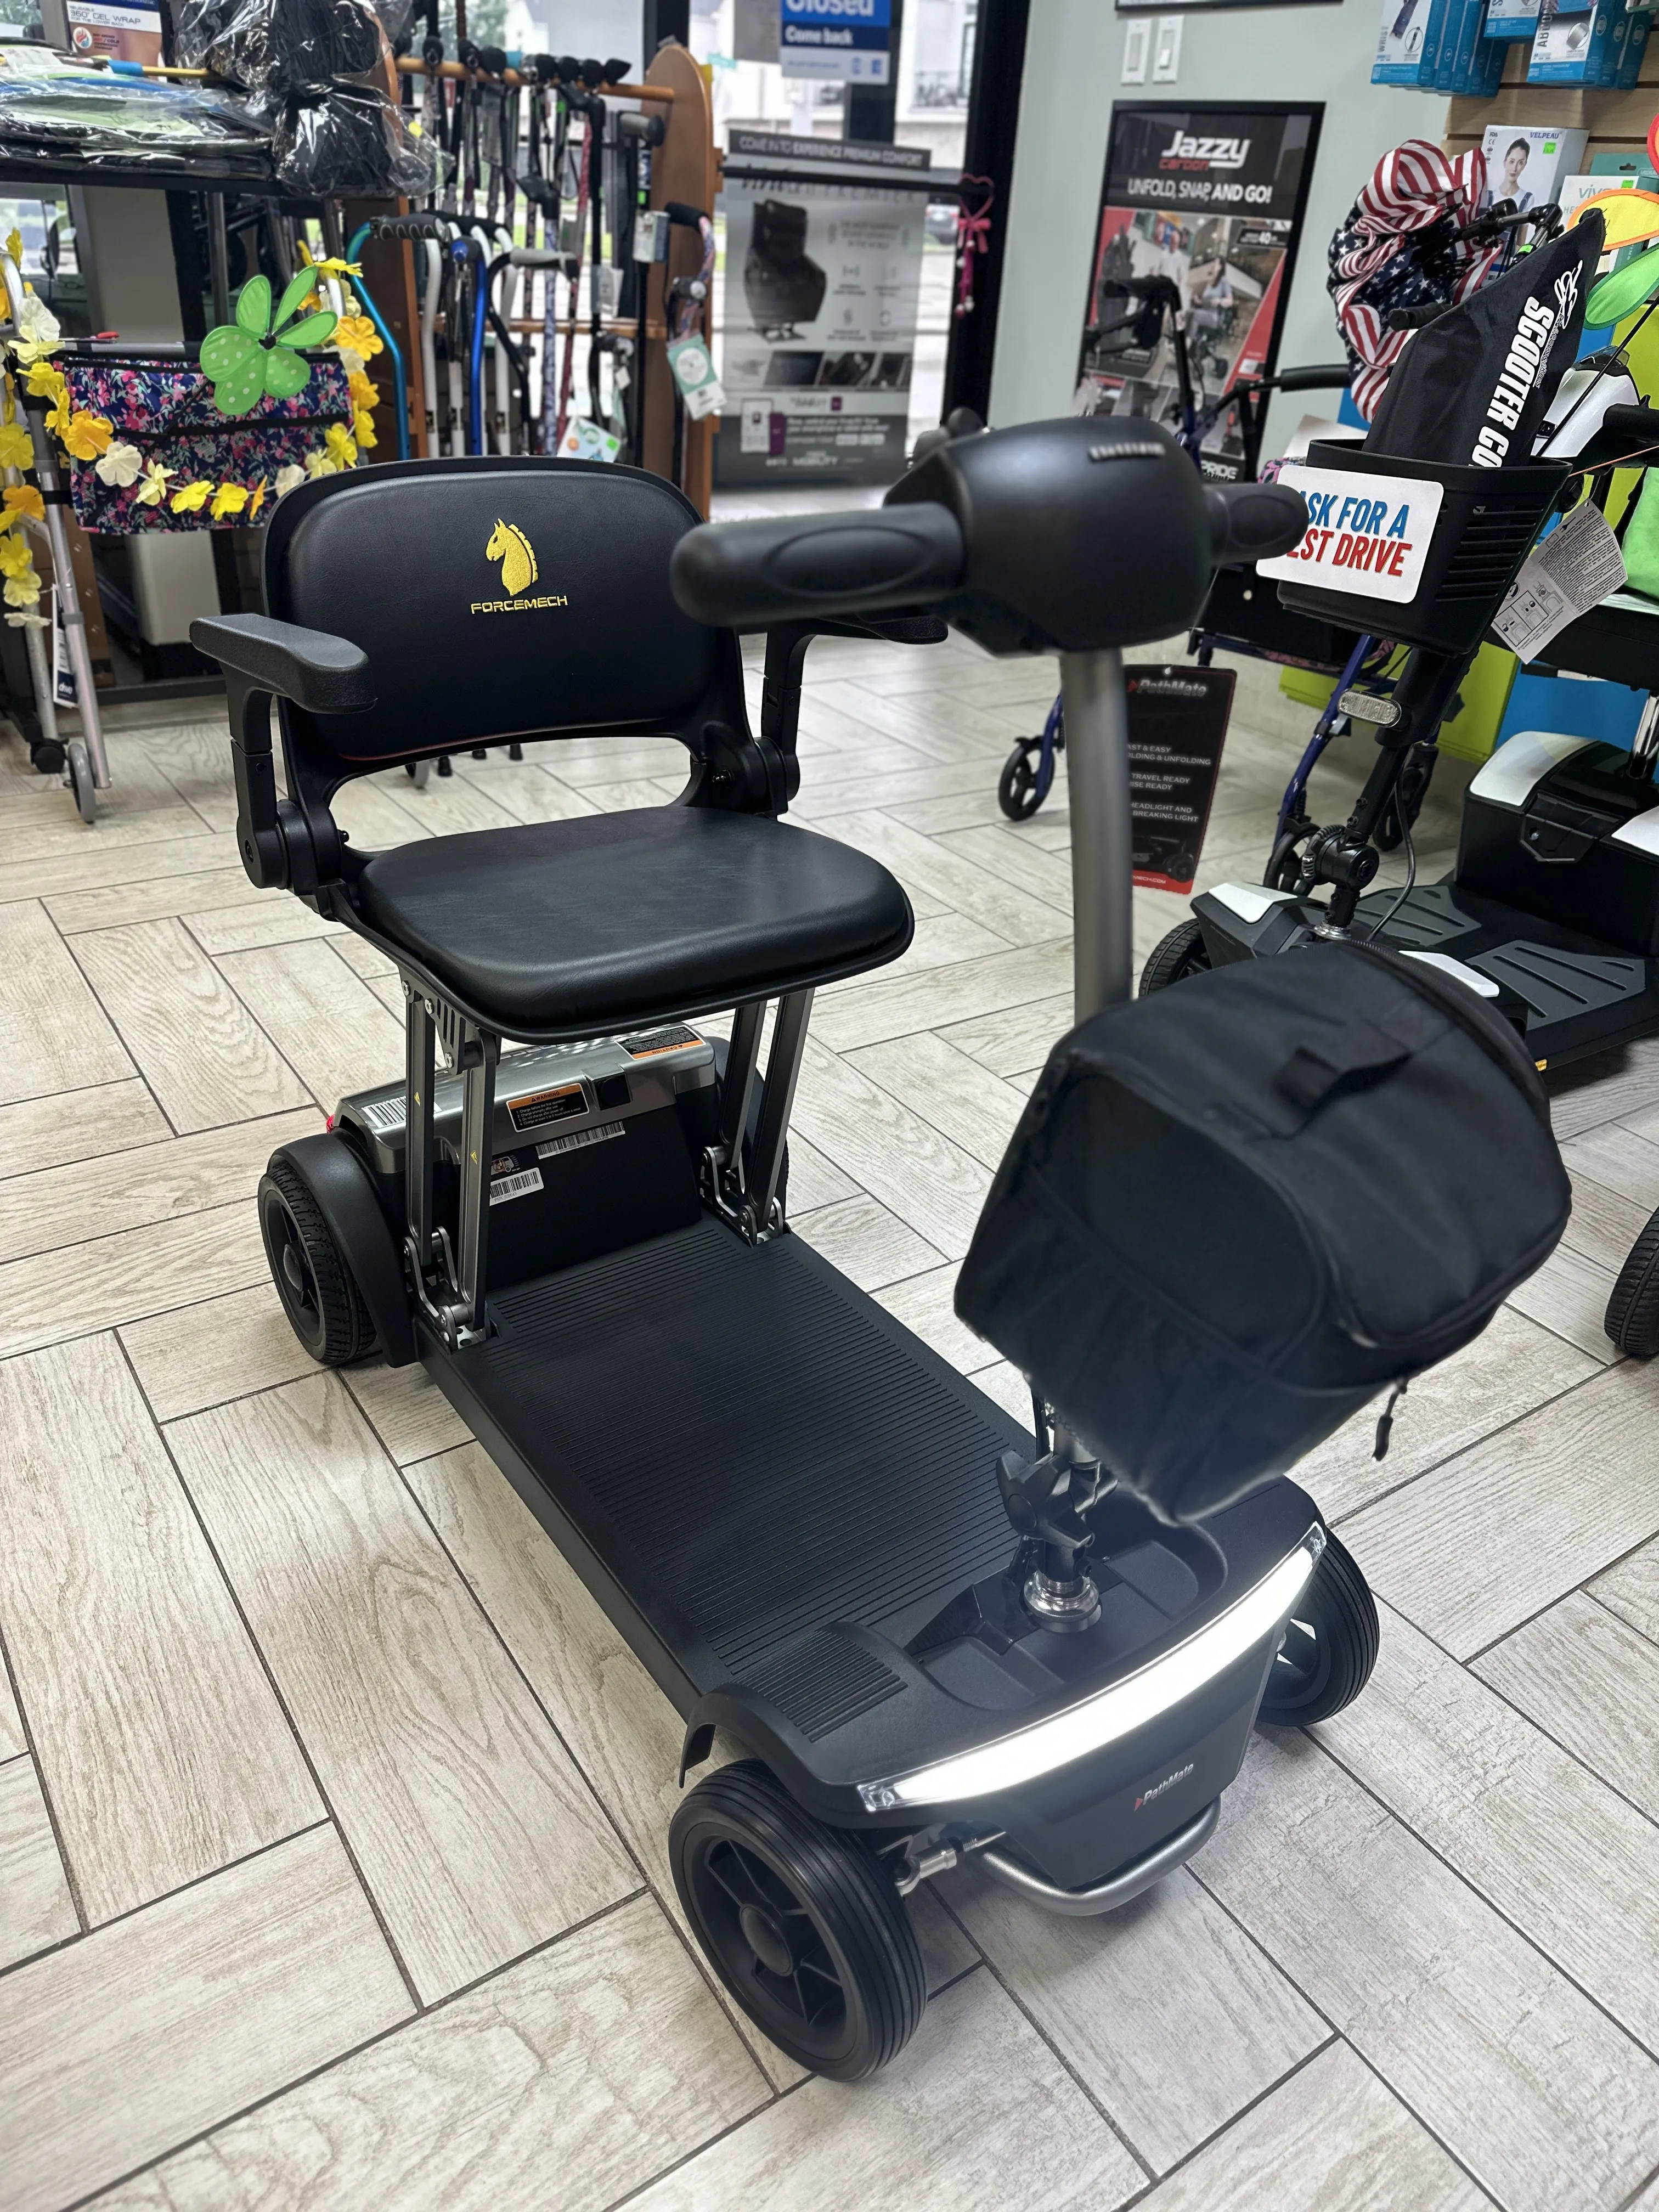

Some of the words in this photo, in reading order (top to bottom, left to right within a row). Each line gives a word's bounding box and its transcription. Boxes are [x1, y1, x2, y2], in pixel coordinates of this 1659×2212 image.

[93, 13, 110, 21] GEL
[112, 15, 141, 24] WRAP
[1161, 130, 1251, 169] Jazzy
[1211, 183, 1244, 202] AND
[1244, 184, 1273, 204] GO!
[1579, 184, 1611, 199] viv
[1487, 296, 1555, 431] SCOOTER
[1469, 426, 1509, 468] GO
[1299, 490, 1339, 528] SK
[1336, 496, 1388, 535] FOR
[1386, 504, 1409, 539] A
[1286, 528, 1335, 563] ST
[1331, 533, 1413, 577] DRIVE
[470, 595, 569, 615] FORCEMECH
[58, 682, 74, 695] drive
[1137, 679, 1208, 697] PathMate
[1164, 755, 1211, 765] UNFOLDING
[1132, 773, 1162, 781] TRAVEL
[1163, 776, 1190, 784] READY
[1146, 782, 1172, 791] READY
[1132, 810, 1173, 820] BREAKING
[1175, 814, 1199, 822] LIGHT
[652, 1045, 678, 1054] CAUTION
[535, 1091, 560, 1101] WARNING
[1142, 1763, 1194, 1806] PathMate
